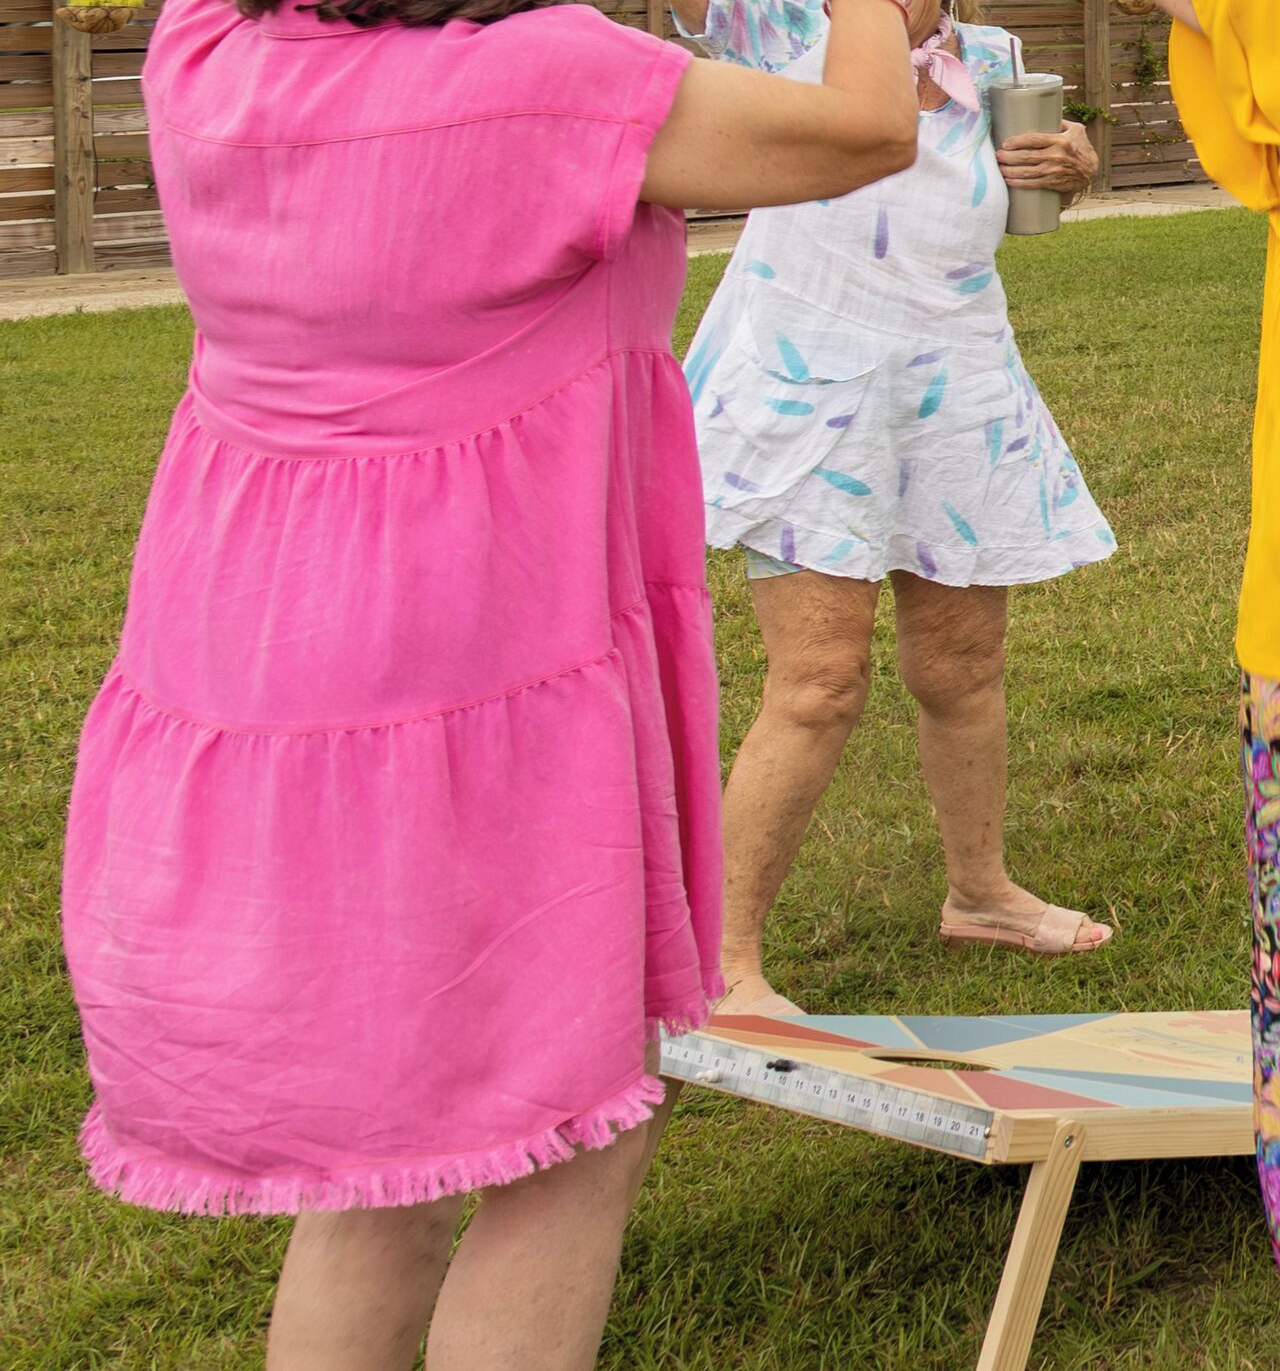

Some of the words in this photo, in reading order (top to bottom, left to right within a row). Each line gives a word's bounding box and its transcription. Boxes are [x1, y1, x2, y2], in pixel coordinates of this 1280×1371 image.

[730, 1063, 737, 1071] 7
[763, 1071, 769, 1080] 9
[779, 1076, 787, 1085] 10
[795, 1080, 804, 1090] 11
[813, 1085, 822, 1095] 12
[829, 1089, 838, 1099] 13
[847, 1094, 856, 1104] 14
[862, 1098, 872, 1108] 15
[881, 1103, 890, 1113] 16
[898, 1108, 908, 1118] 17
[915, 1112, 925, 1122] 18
[933, 1117, 943, 1127] 19
[950, 1121, 961, 1132] 20
[969, 1126, 979, 1136] 21
